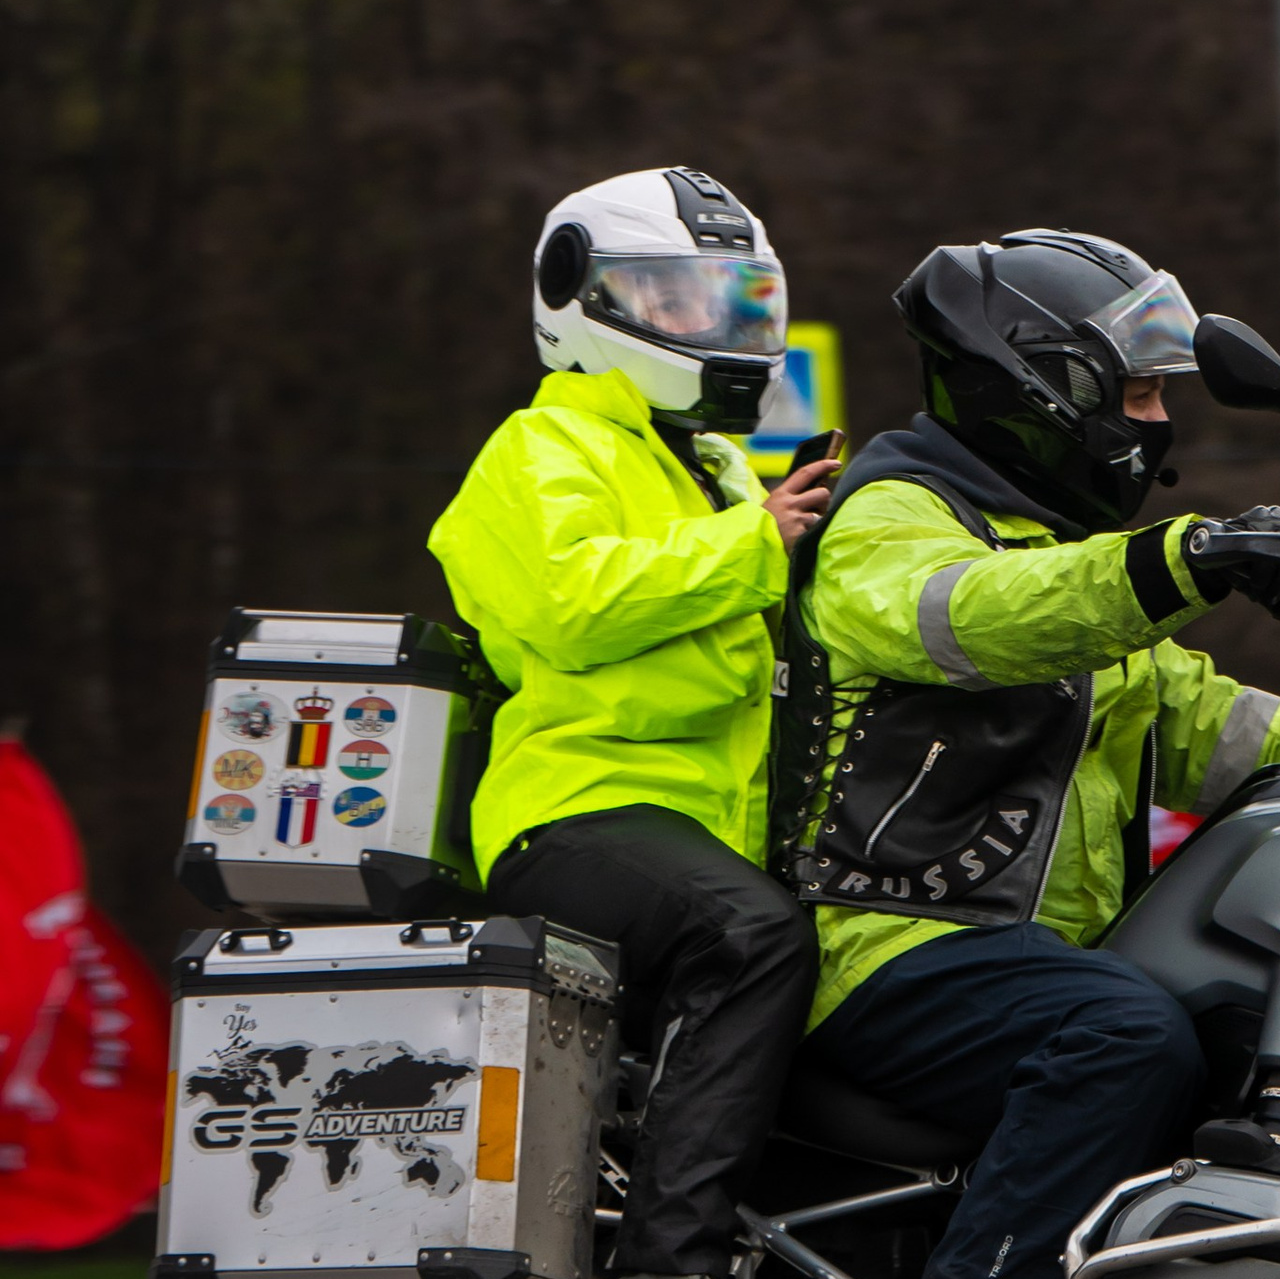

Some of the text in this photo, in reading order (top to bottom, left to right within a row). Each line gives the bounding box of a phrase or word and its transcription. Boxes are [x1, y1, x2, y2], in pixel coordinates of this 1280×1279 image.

[697, 213, 748, 228] LS2
[219, 757, 256, 780] MK
[356, 751, 373, 771] H
[838, 809, 1030, 901] RUSSIA
[234, 1002, 251, 1014] Say
[223, 1014, 257, 1039] Yes
[193, 1107, 466, 1149] GS ADVENTURE
[988, 1234, 1014, 1278] TRIBORD
